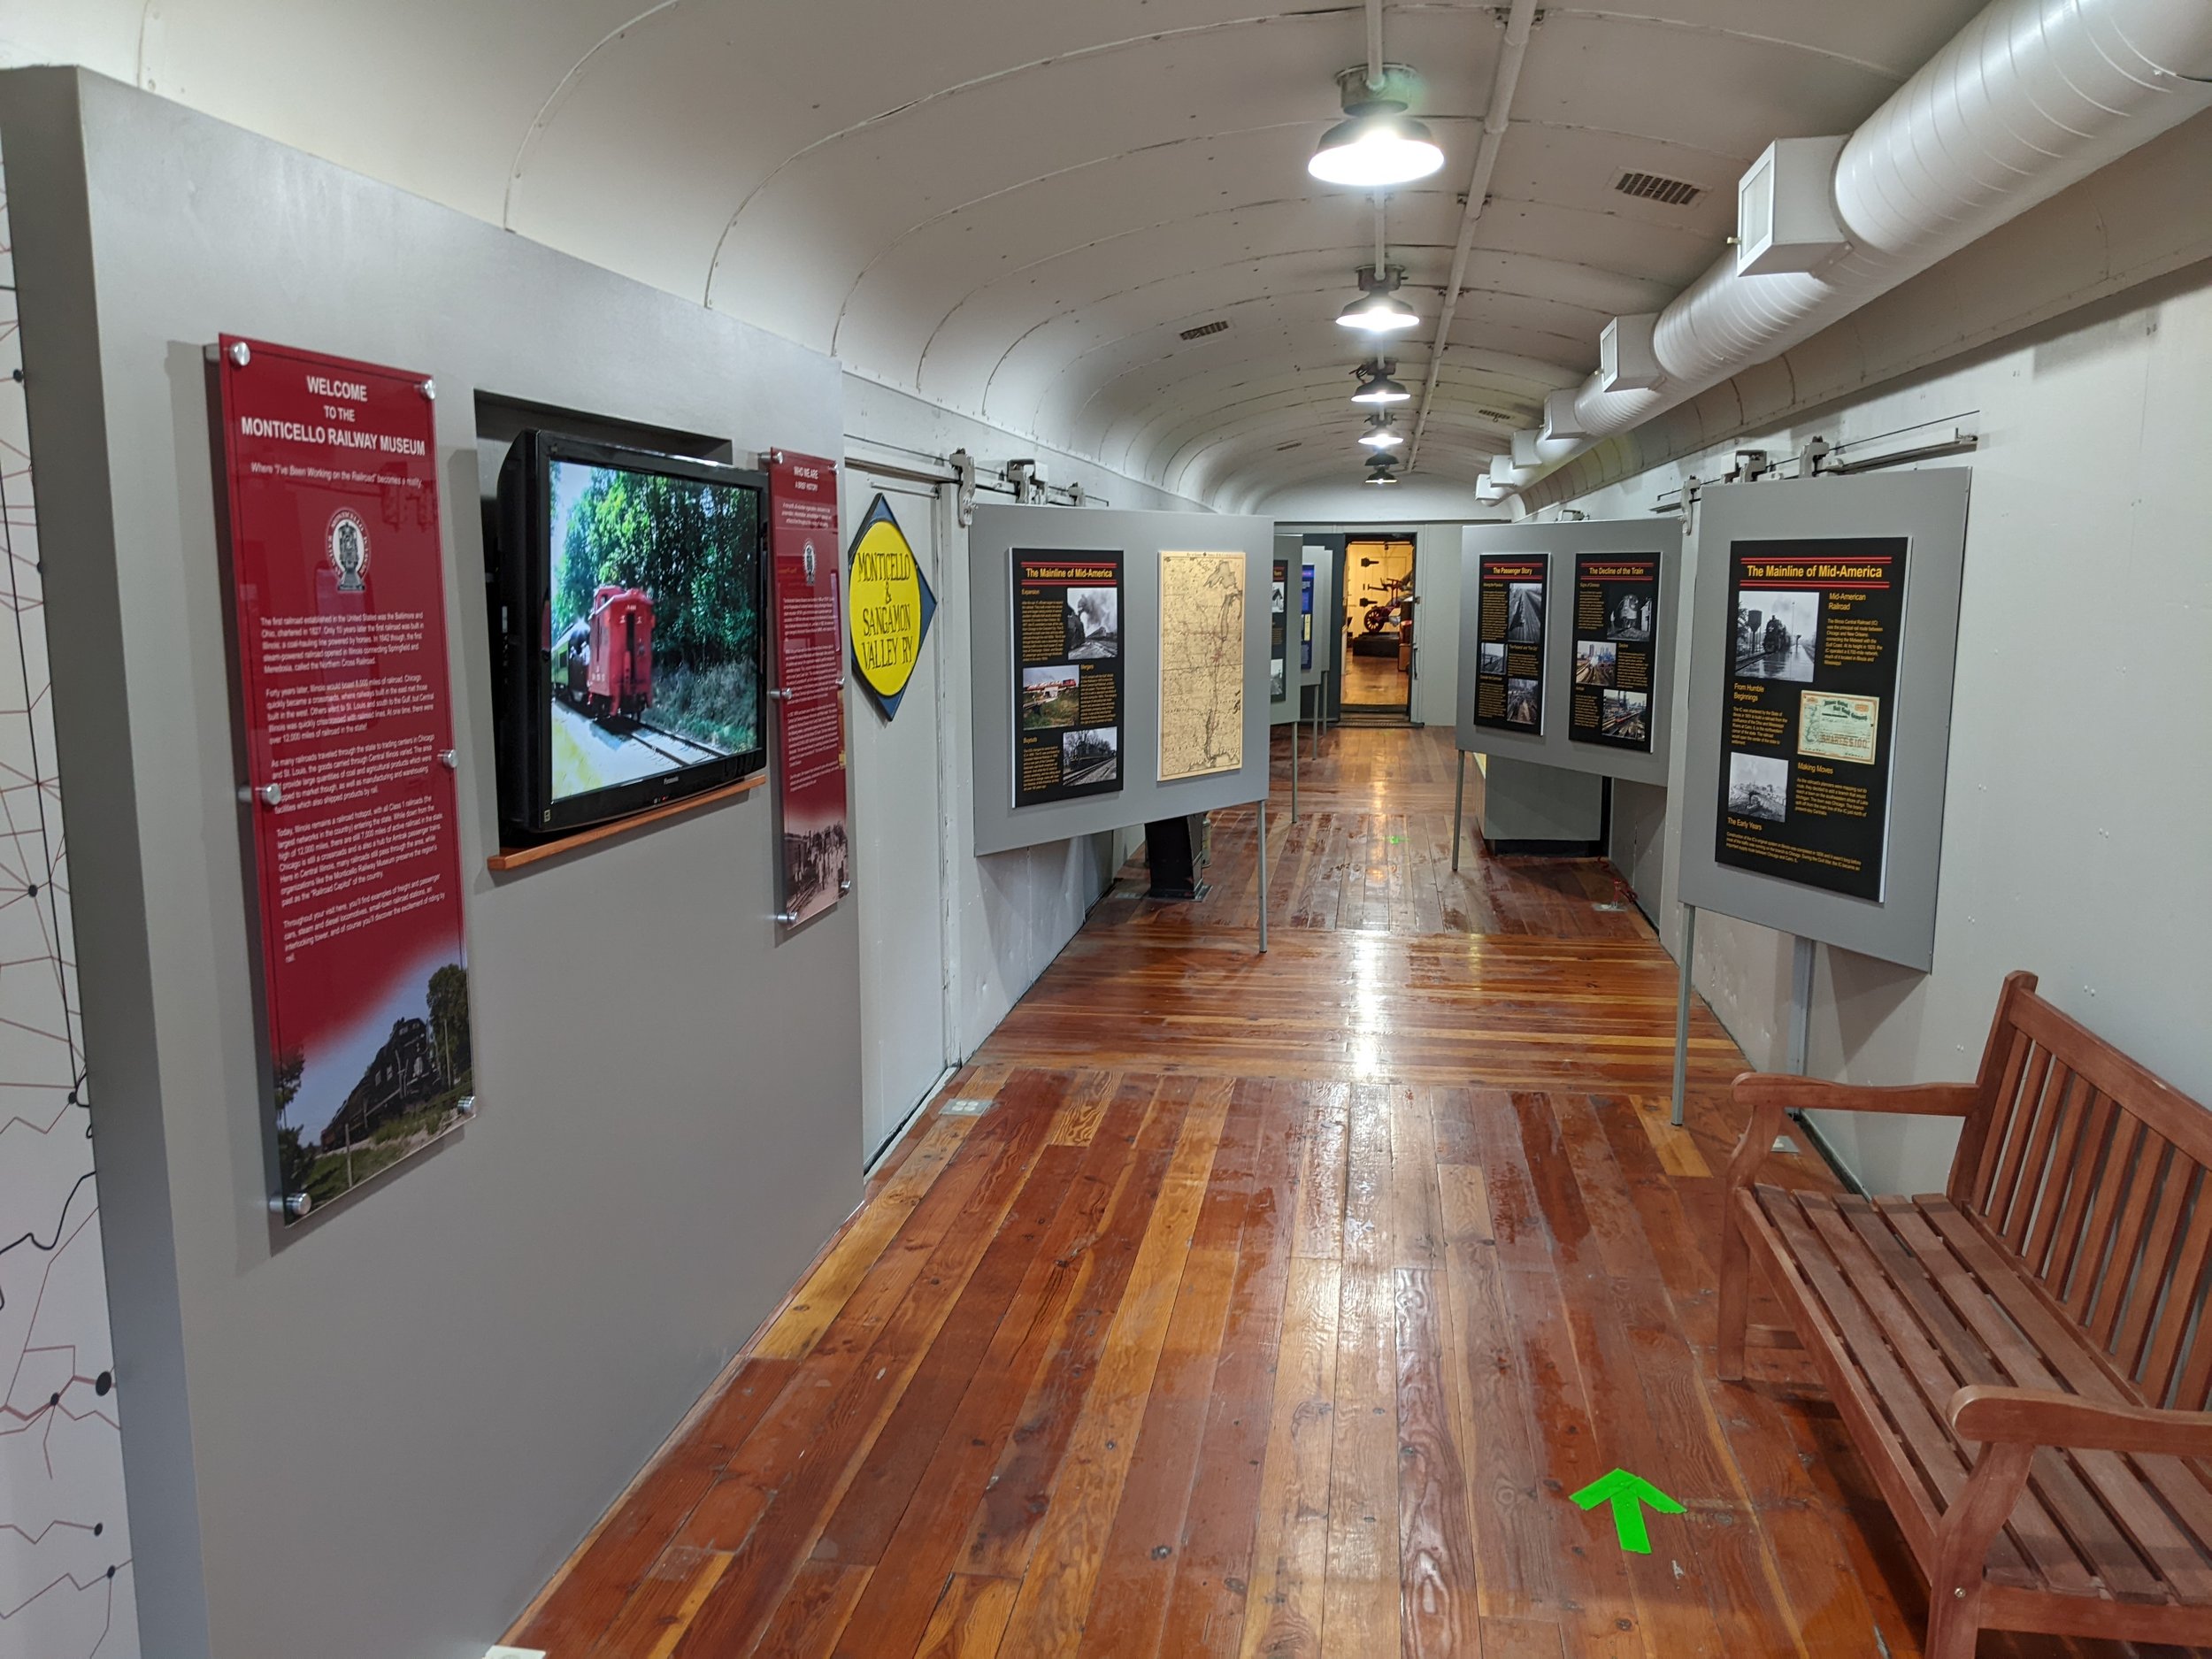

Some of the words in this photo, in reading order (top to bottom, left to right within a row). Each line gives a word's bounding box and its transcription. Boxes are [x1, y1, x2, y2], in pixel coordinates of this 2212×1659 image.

[307, 375, 368, 402] WELCOME
[324, 405, 336, 419] TO
[338, 406, 355, 422] THE
[242, 417, 325, 444] MONTICELLO
[327, 430, 379, 449] RAILWAY
[380, 435, 426, 456] MUSEUM
[250, 463, 273, 473] Where
[289, 466, 306, 477] Been
[307, 468, 332, 481] Working
[342, 472, 350, 480] the
[376, 474, 401, 485] becomes
[857, 550, 910, 582] MONTICELLO
[1026, 568, 1039, 578] The
[1040, 568, 1066, 578] Mainline
[1067, 569, 1075, 578] of
[1075, 569, 1113, 578] Mid-America
[1747, 565, 1763, 577] The
[1766, 565, 1804, 577] Mainline
[1806, 565, 1816, 577] of
[1818, 565, 1882, 578] Mid-America
[884, 581, 893, 605] &
[1829, 592, 1866, 601] Mid-American
[863, 603, 911, 636] SANGAMON
[862, 638, 898, 671] VALLEY
[902, 636, 913, 664] RY
[1734, 682, 1747, 692] From
[1747, 684, 1764, 694] Humble
[1733, 692, 1758, 702] Beginnings
[1798, 762, 1816, 773] Making
[1816, 764, 1833, 774] Moves
[1727, 817, 1736, 826] The
[1737, 818, 1747, 830] Early
[1748, 821, 1763, 831] Years
